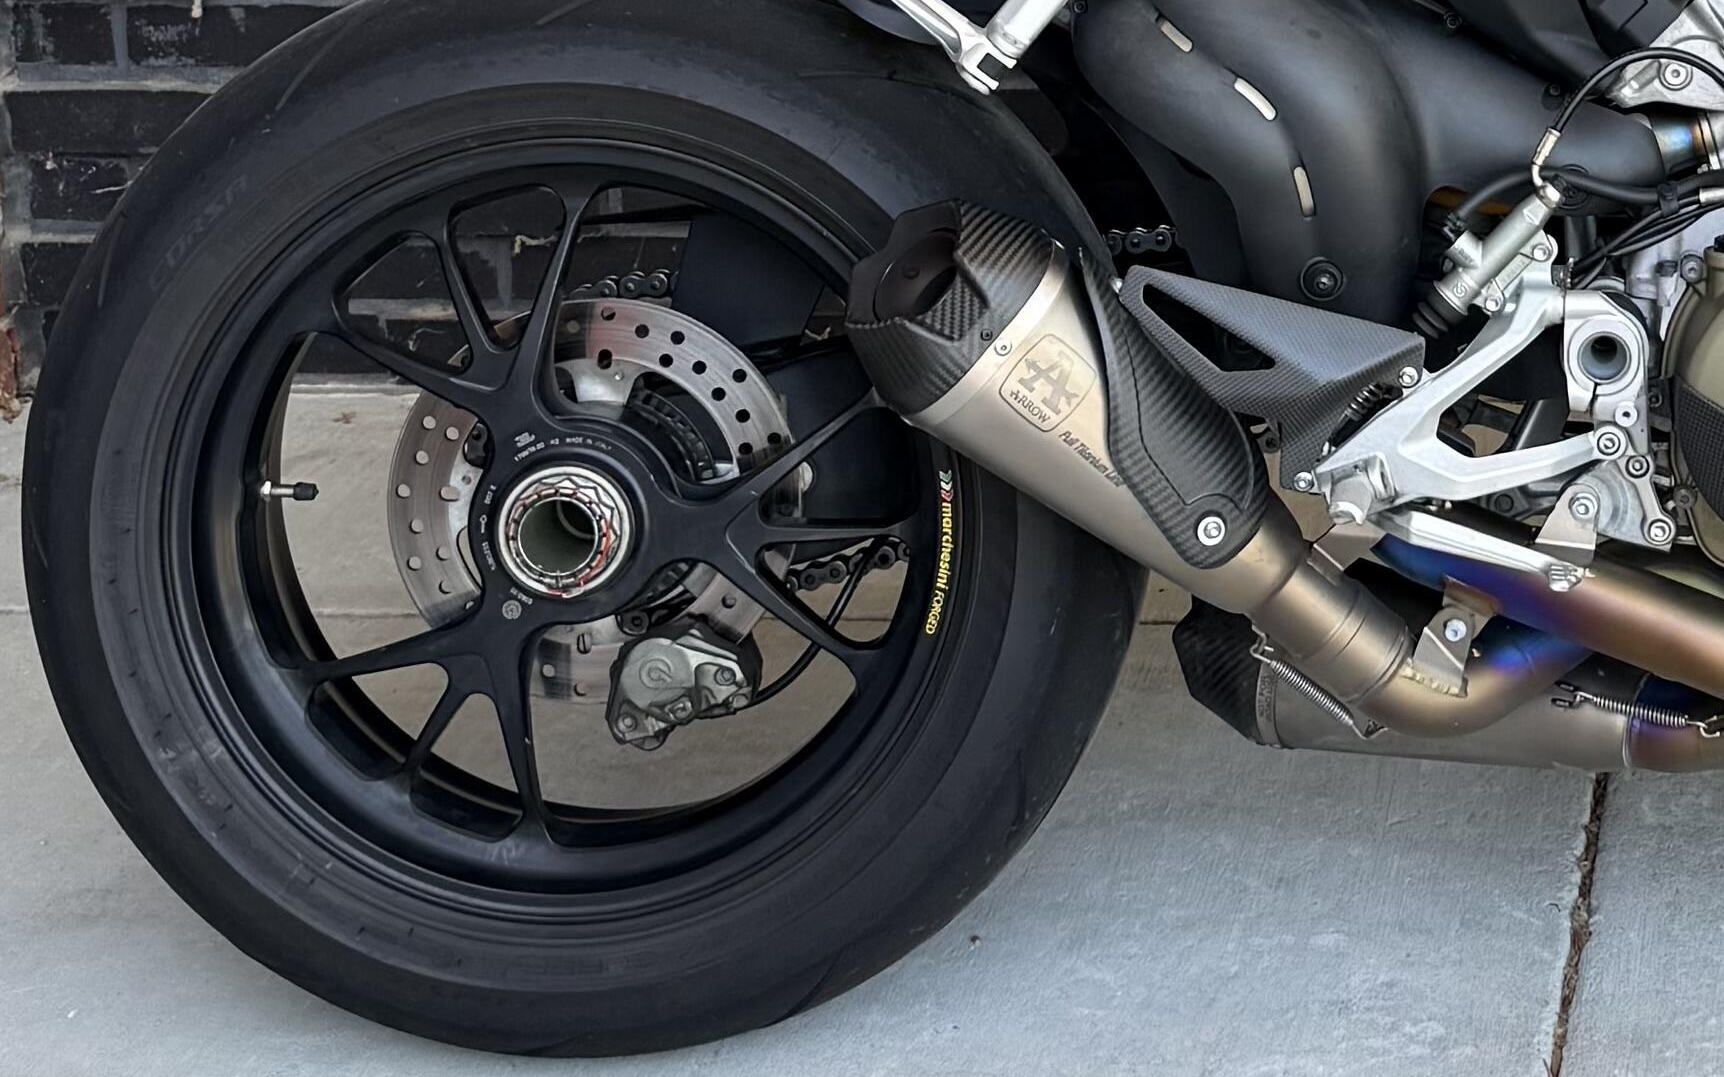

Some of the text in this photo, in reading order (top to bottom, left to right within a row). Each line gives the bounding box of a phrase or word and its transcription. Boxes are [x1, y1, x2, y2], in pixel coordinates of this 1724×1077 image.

[1009, 389, 1051, 423] ARROW
[925, 502, 954, 635] marchesini FORGED
